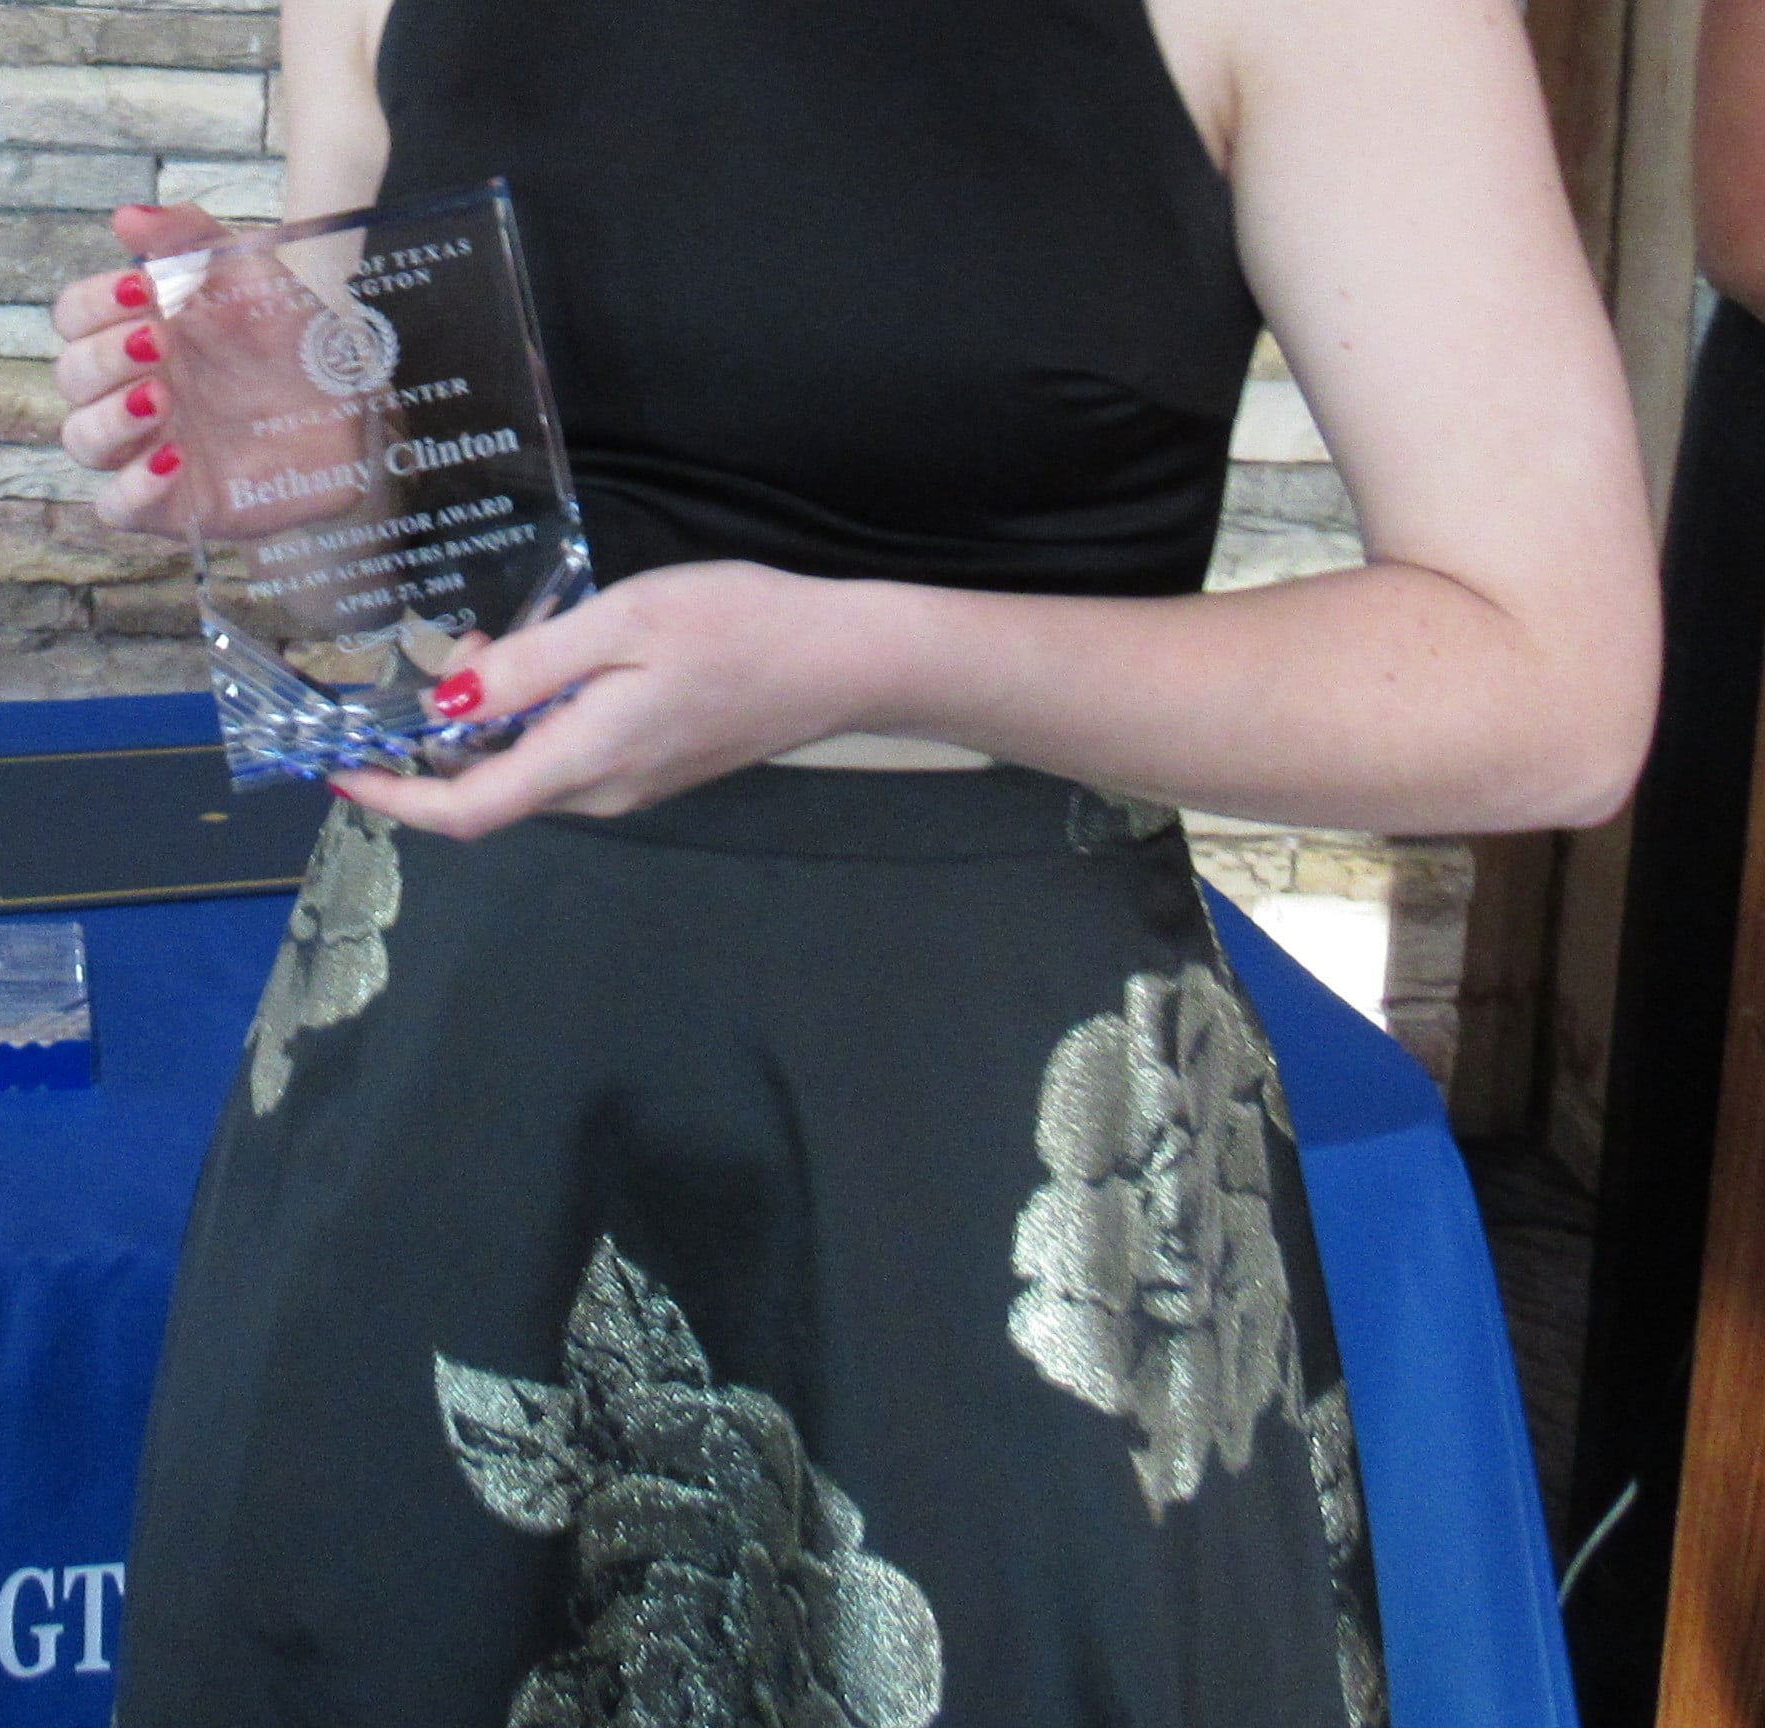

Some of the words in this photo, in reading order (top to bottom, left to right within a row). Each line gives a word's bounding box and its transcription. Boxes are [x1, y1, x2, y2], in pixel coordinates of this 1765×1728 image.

[390, 236, 474, 269] TEXAS
[366, 376, 471, 414] CENTER
[228, 458, 372, 511] Bethany
[386, 427, 520, 477] Clinton
[437, 494, 514, 527] AWARD
